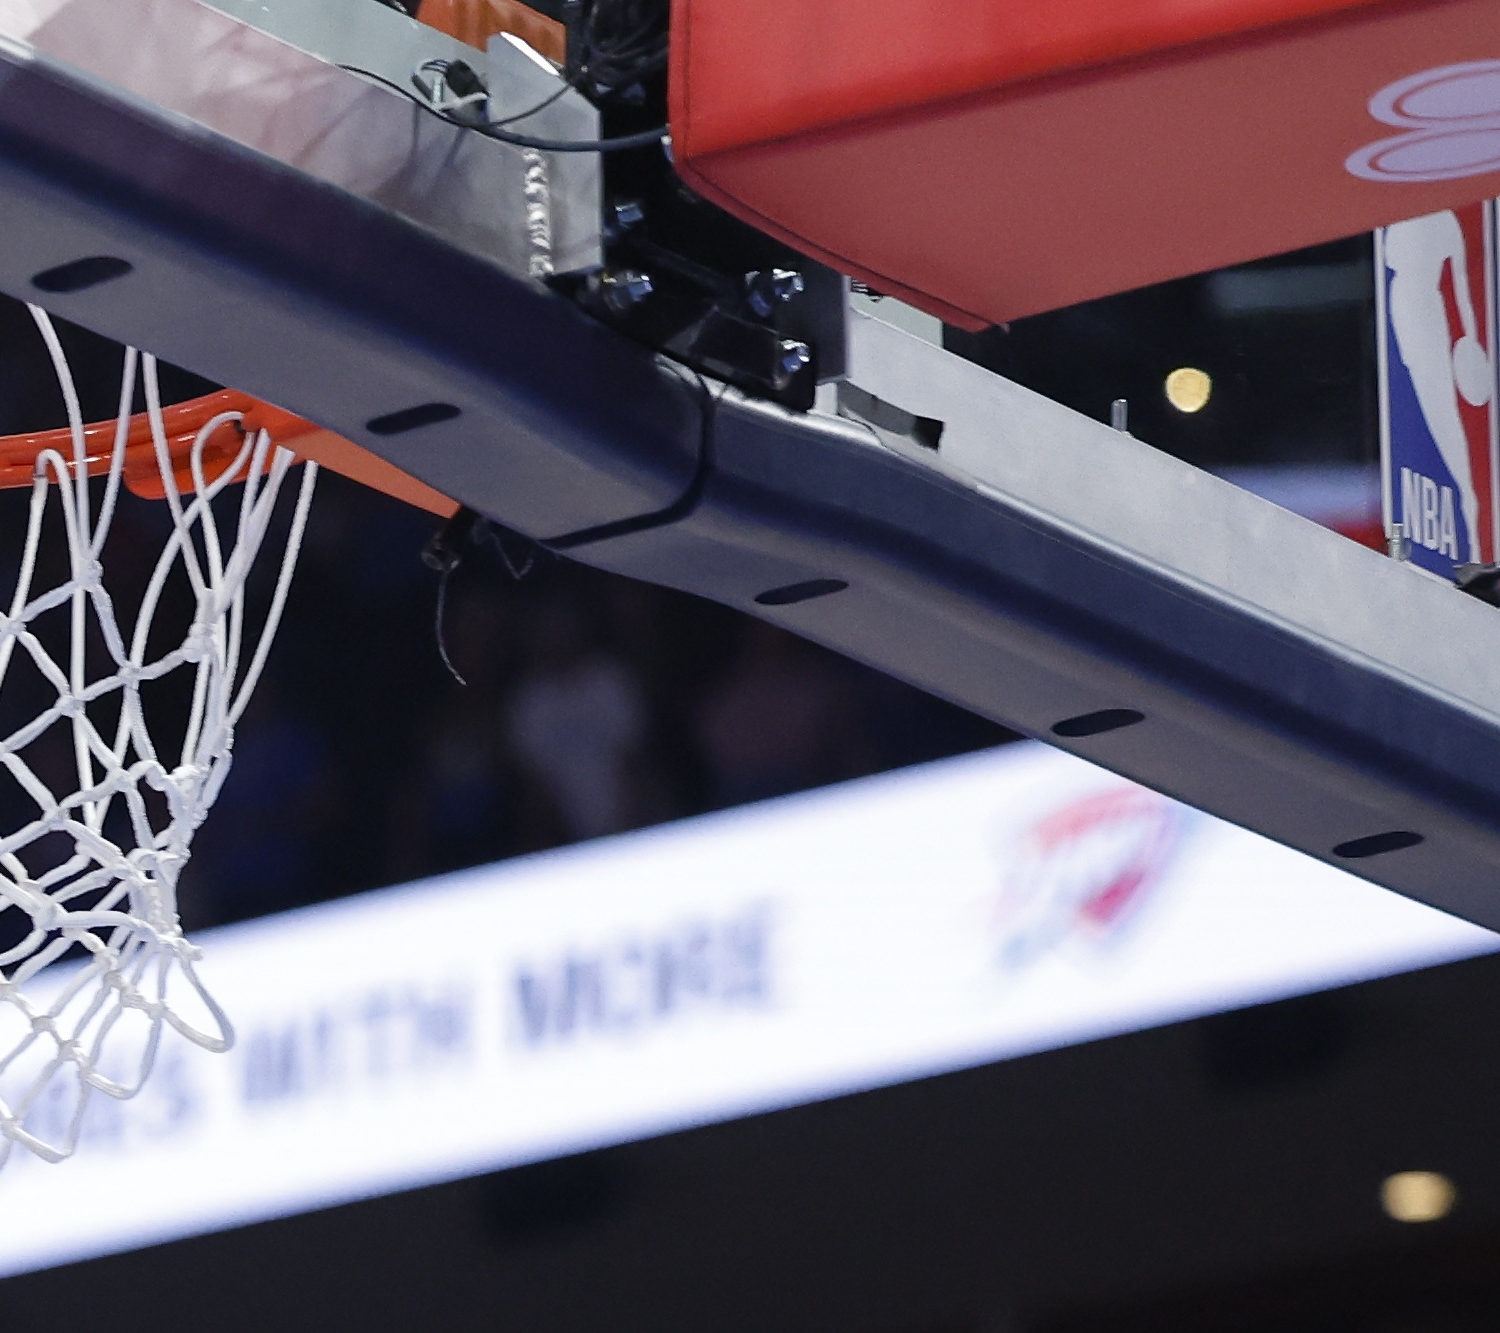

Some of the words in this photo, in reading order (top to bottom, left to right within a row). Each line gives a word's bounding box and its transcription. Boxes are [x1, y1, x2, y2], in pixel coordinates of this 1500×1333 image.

[1400, 466, 1459, 561] NBA
[233, 975, 478, 1110] WITH
[507, 895, 789, 1050] MORE
